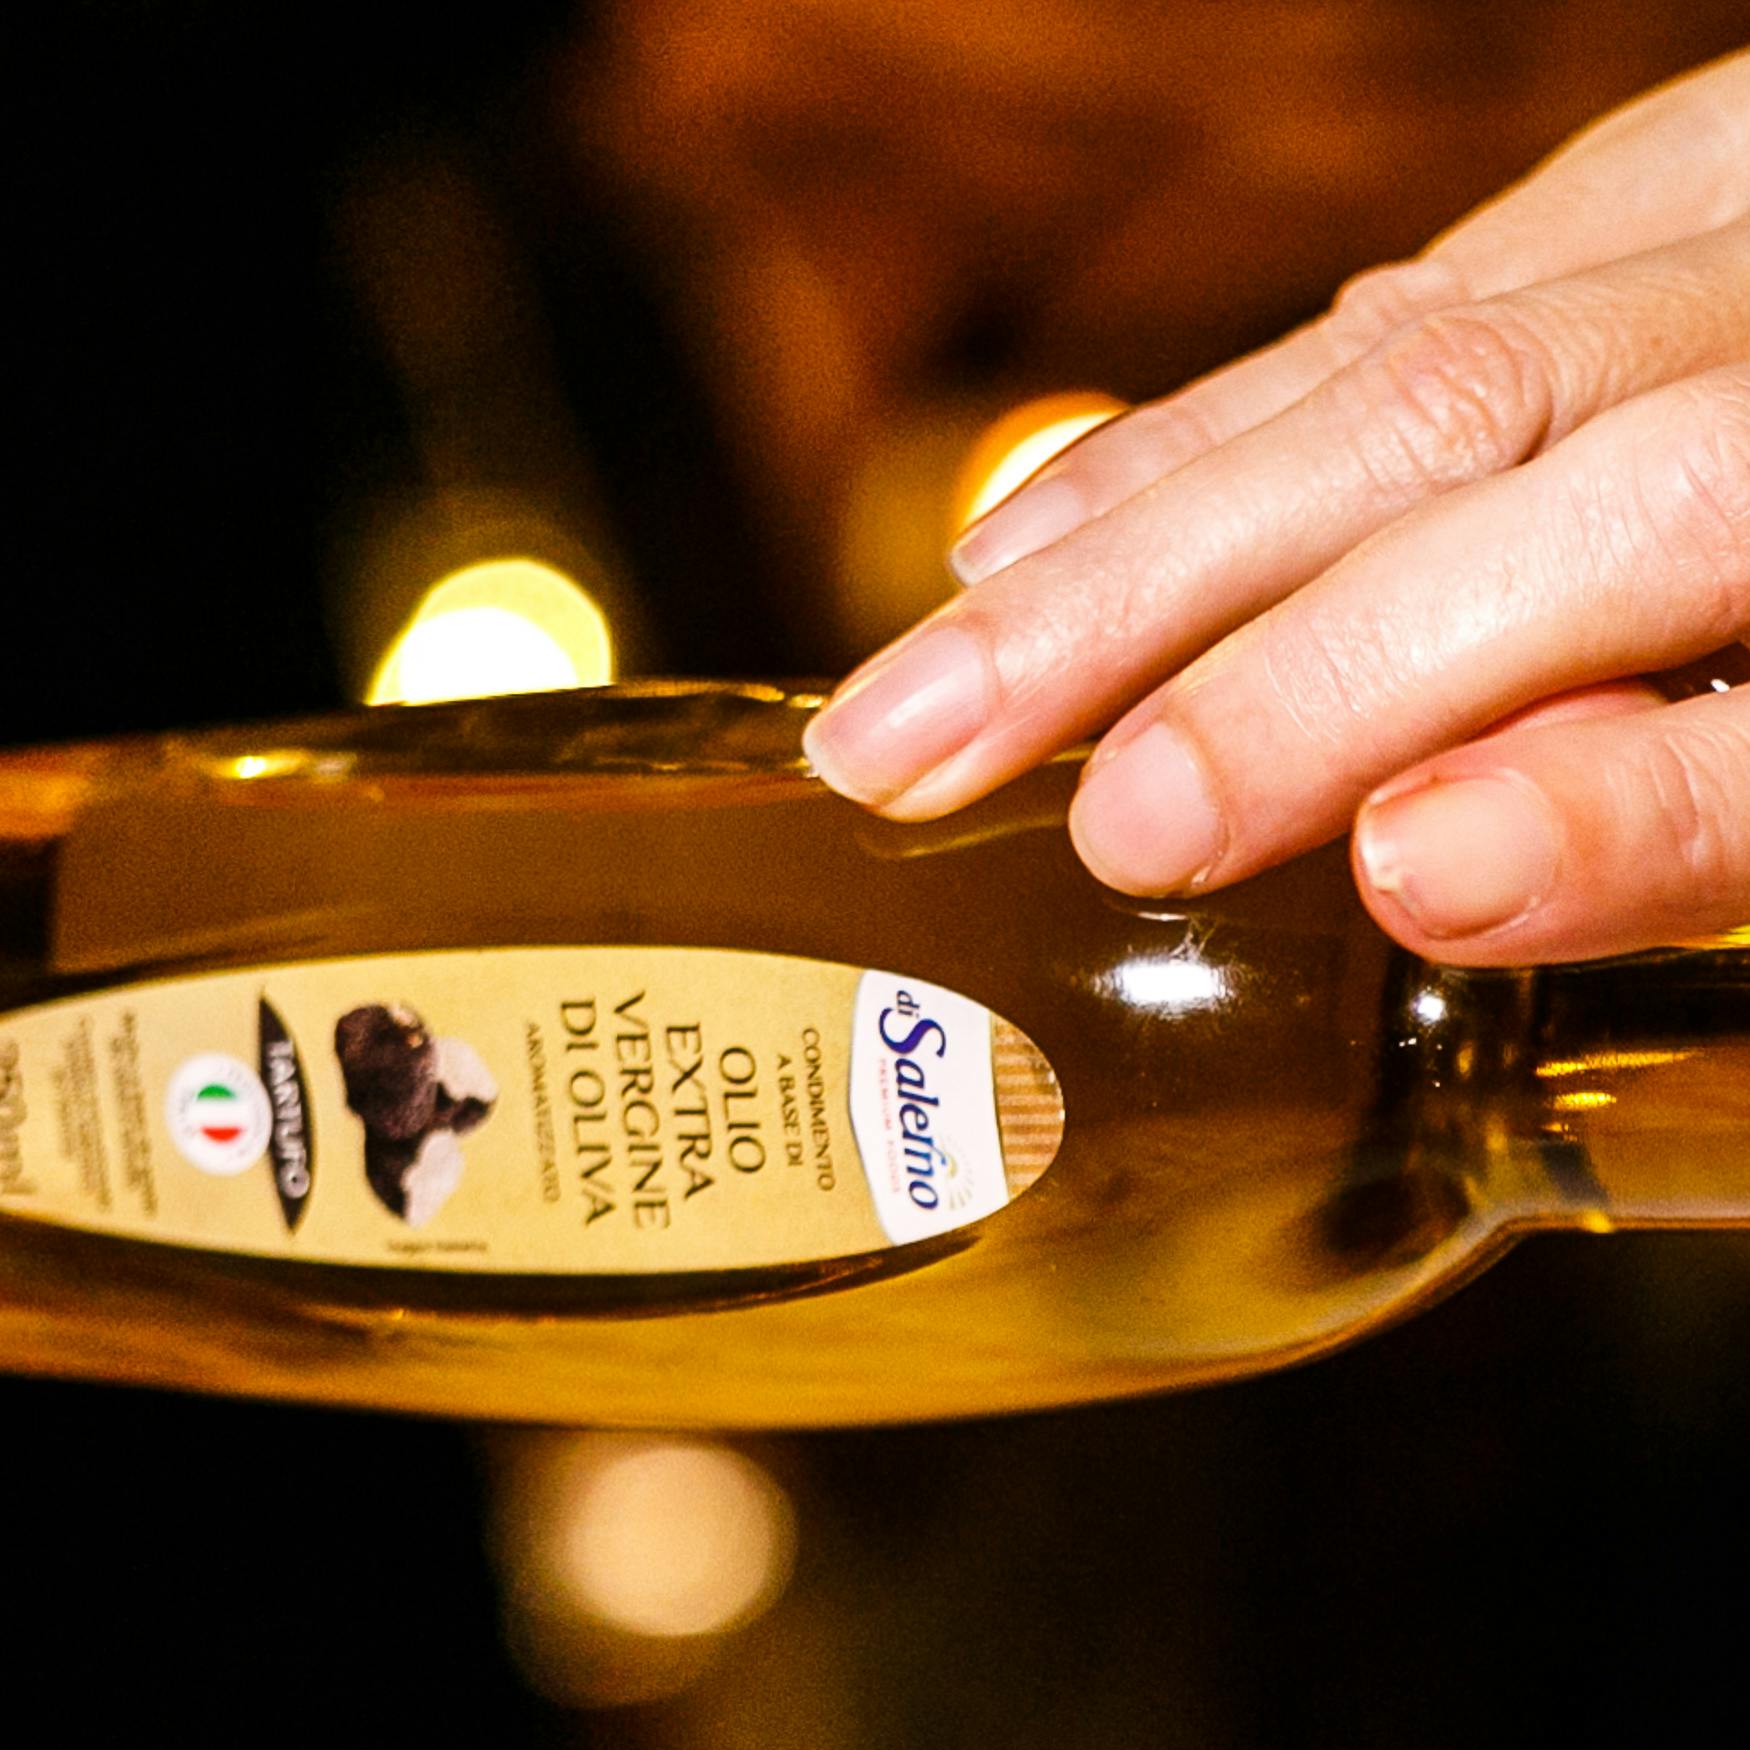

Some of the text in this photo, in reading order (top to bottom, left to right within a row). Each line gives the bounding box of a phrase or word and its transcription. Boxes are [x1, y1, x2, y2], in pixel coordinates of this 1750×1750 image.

[560, 997, 617, 1227] DI OLIVA
[613, 990, 670, 1229] VERGINE
[666, 1021, 715, 1200] EXTRA
[718, 1046, 767, 1174] OLIO
[776, 1053, 803, 1167] A BASE DI
[801, 1027, 835, 1192] CONDIMENTO
[878, 989, 947, 1211] di Salerno
